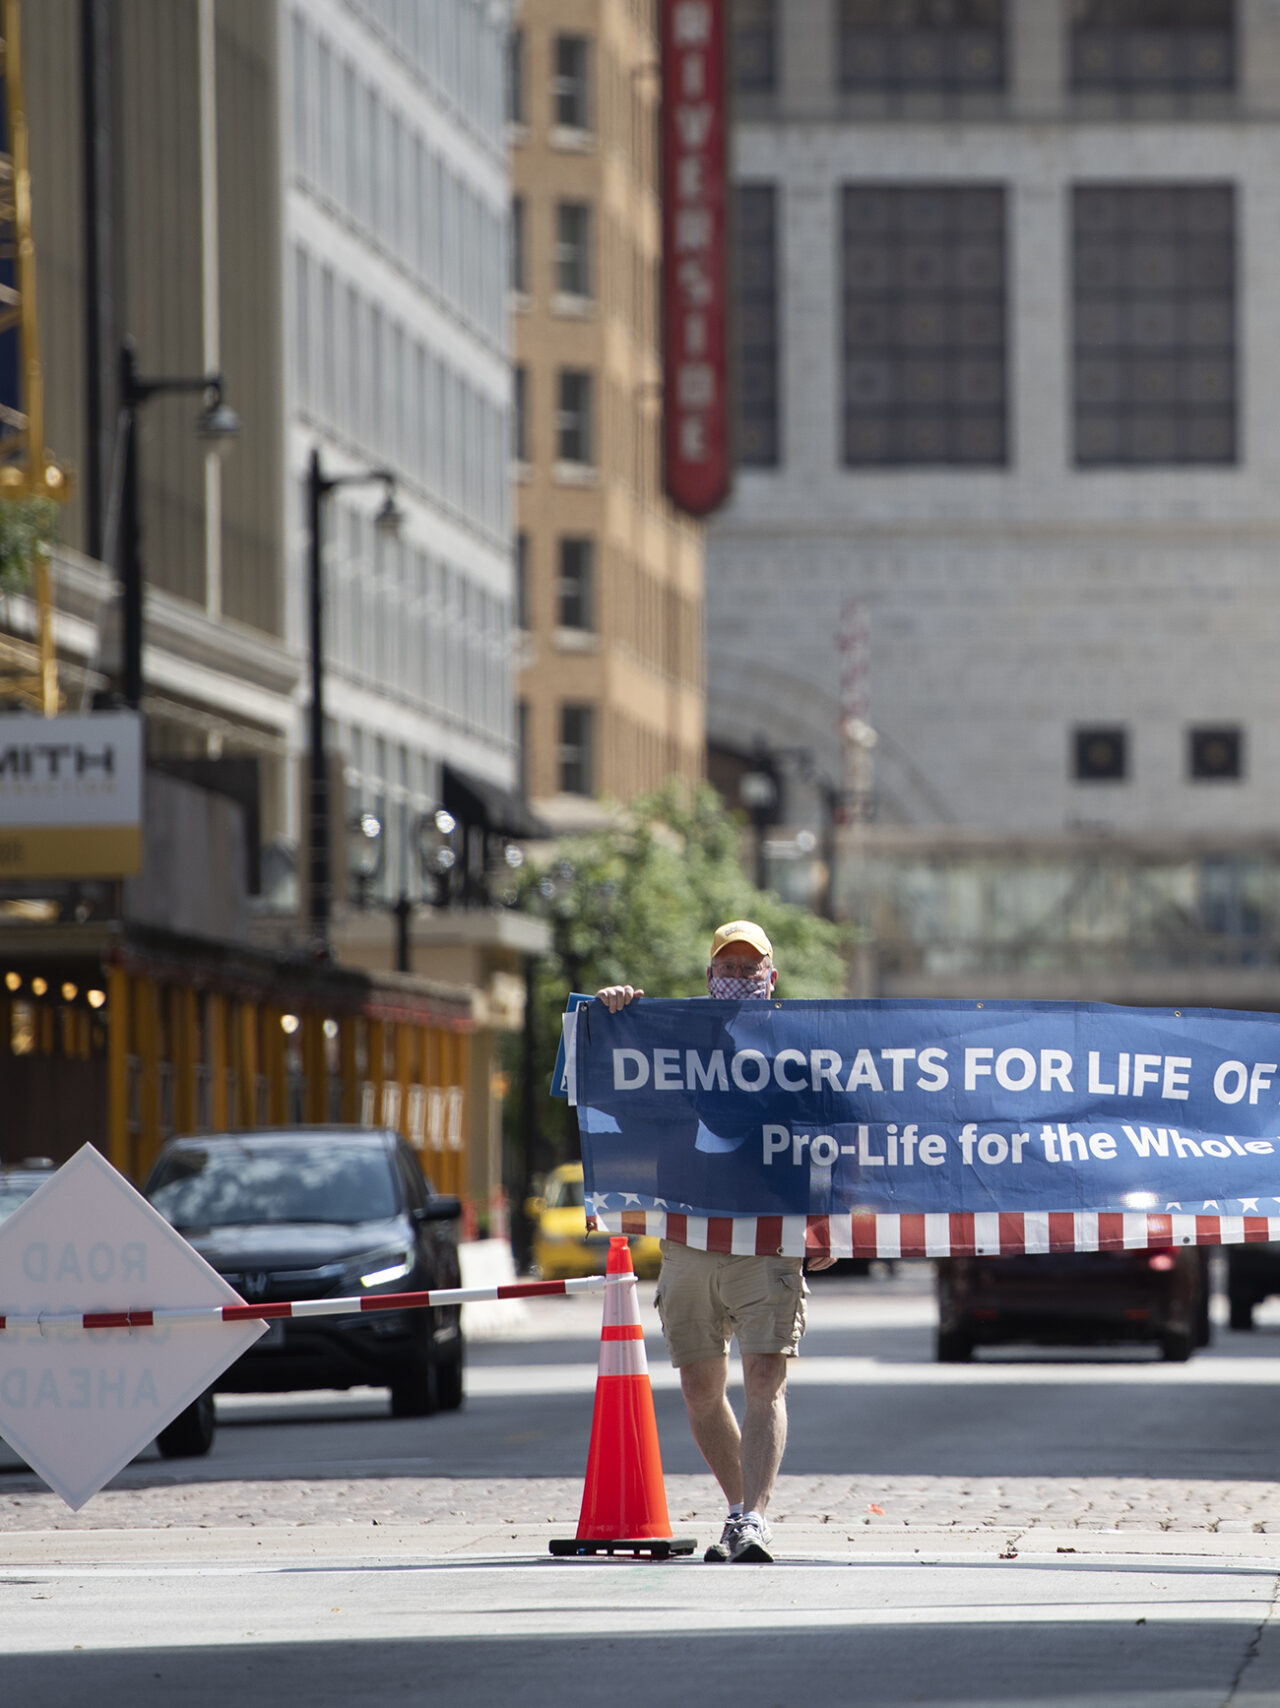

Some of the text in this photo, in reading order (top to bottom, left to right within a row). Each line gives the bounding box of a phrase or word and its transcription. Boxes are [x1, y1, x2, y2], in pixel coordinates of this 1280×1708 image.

[612, 1047, 949, 1092] DEMOCRATS
[964, 1047, 1074, 1092] FOR
[1088, 1050, 1192, 1100] LIFE
[1213, 1060, 1277, 1105] OF
[762, 1123, 947, 1166] Pro-Life
[958, 1123, 1030, 1166] for
[1039, 1122, 1117, 1162] the
[1121, 1125, 1275, 1159] Whole
